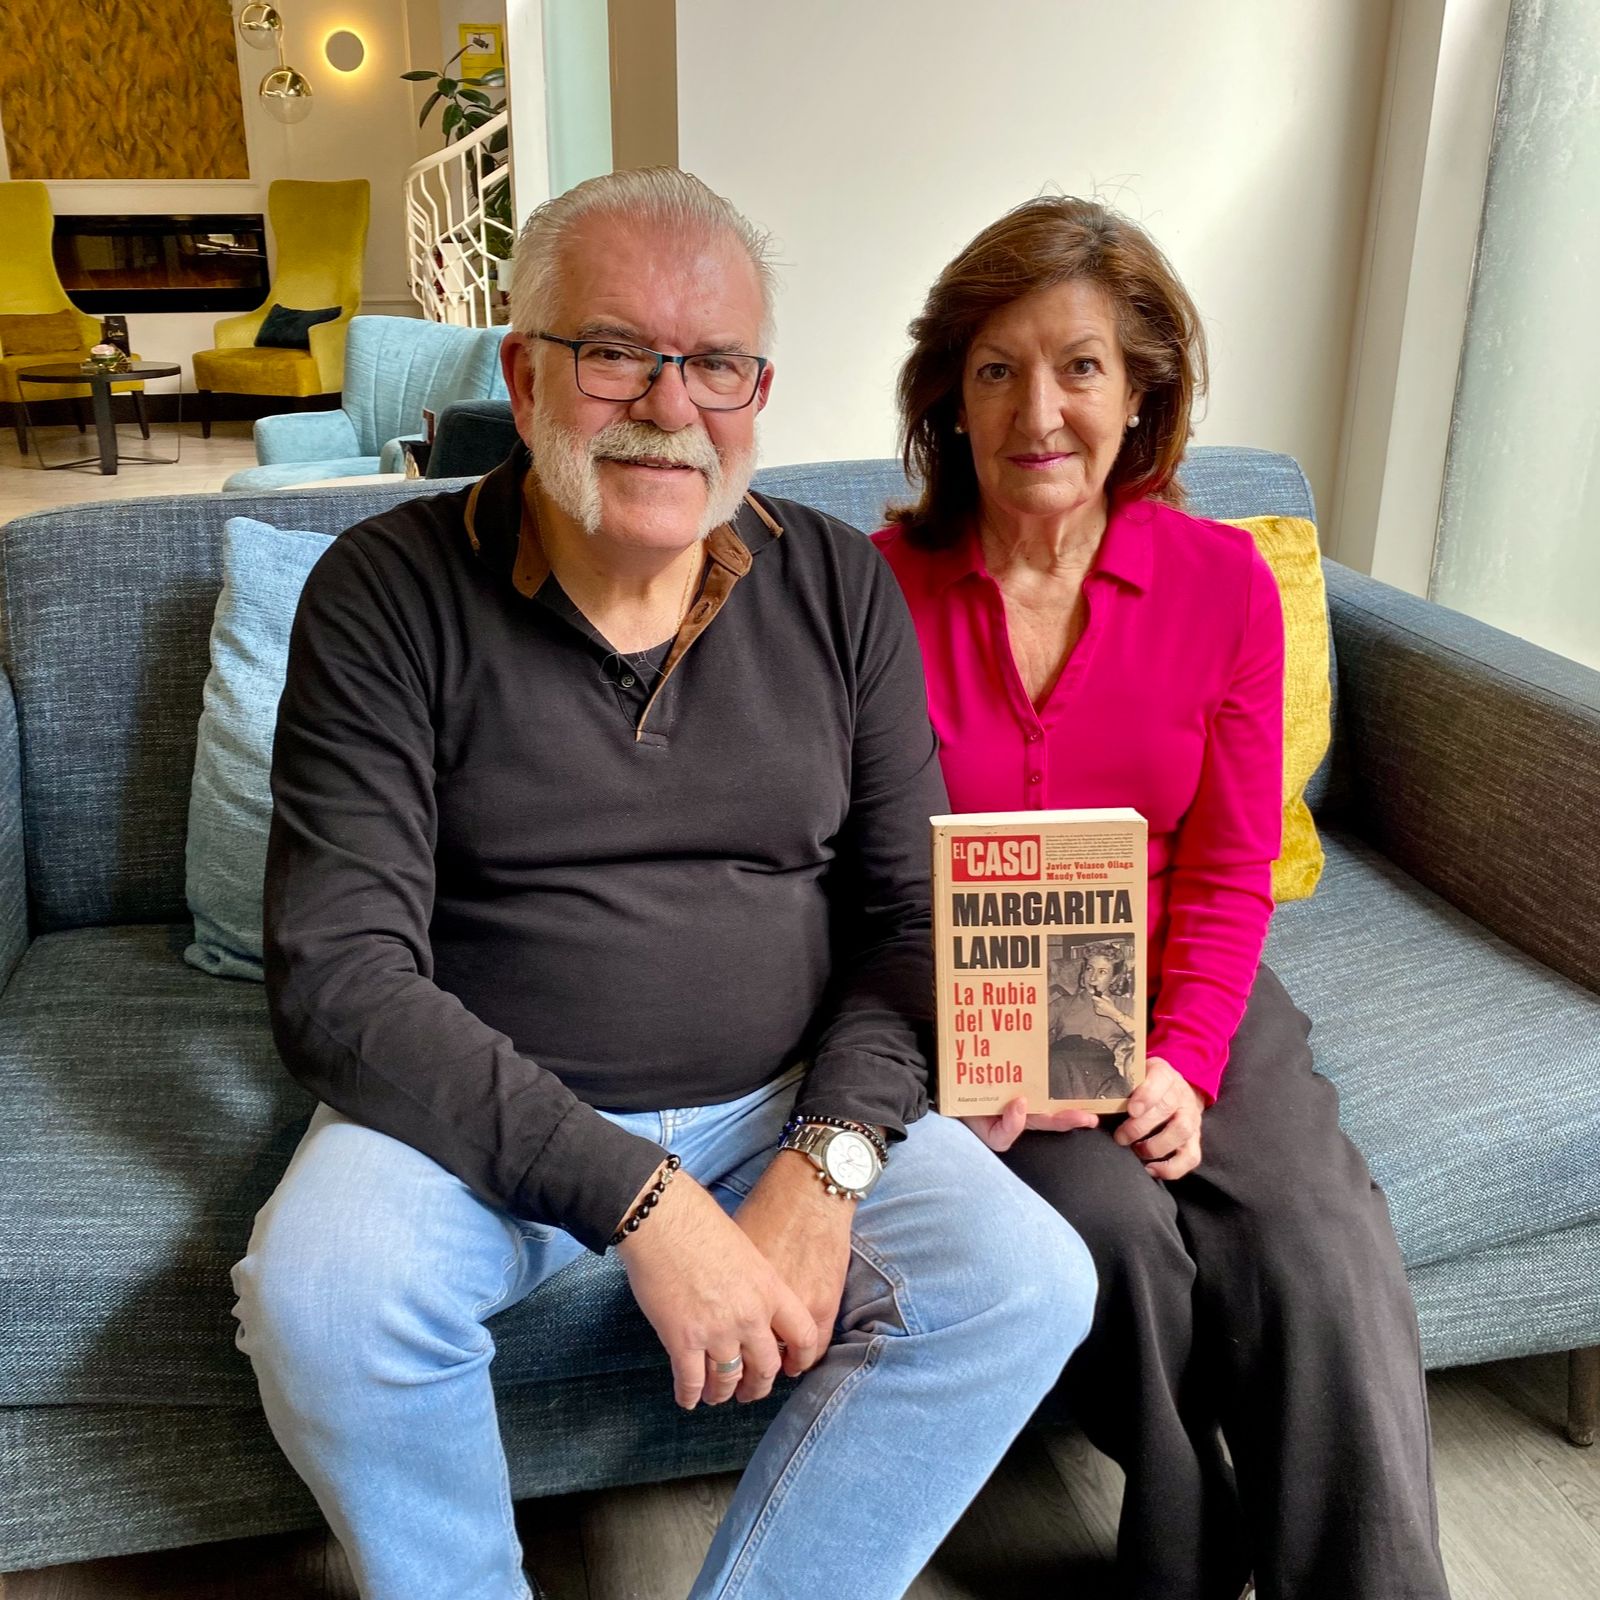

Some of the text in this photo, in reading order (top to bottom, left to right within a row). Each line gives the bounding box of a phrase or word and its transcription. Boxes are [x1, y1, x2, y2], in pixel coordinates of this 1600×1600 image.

[953, 843, 966, 859] EL
[967, 840, 1038, 877] CASO
[1046, 862, 1071, 871] Javier
[1074, 861, 1104, 870] Velasco
[1046, 871, 1108, 881] Maudy Ventosa
[952, 890, 1133, 926] MARGARITA
[953, 935, 1040, 969] LANDI
[954, 982, 1036, 1006] La Rubia
[955, 1008, 1032, 1032] del Velo
[955, 1034, 990, 1060] y la
[956, 1061, 1022, 1084] Pistola
